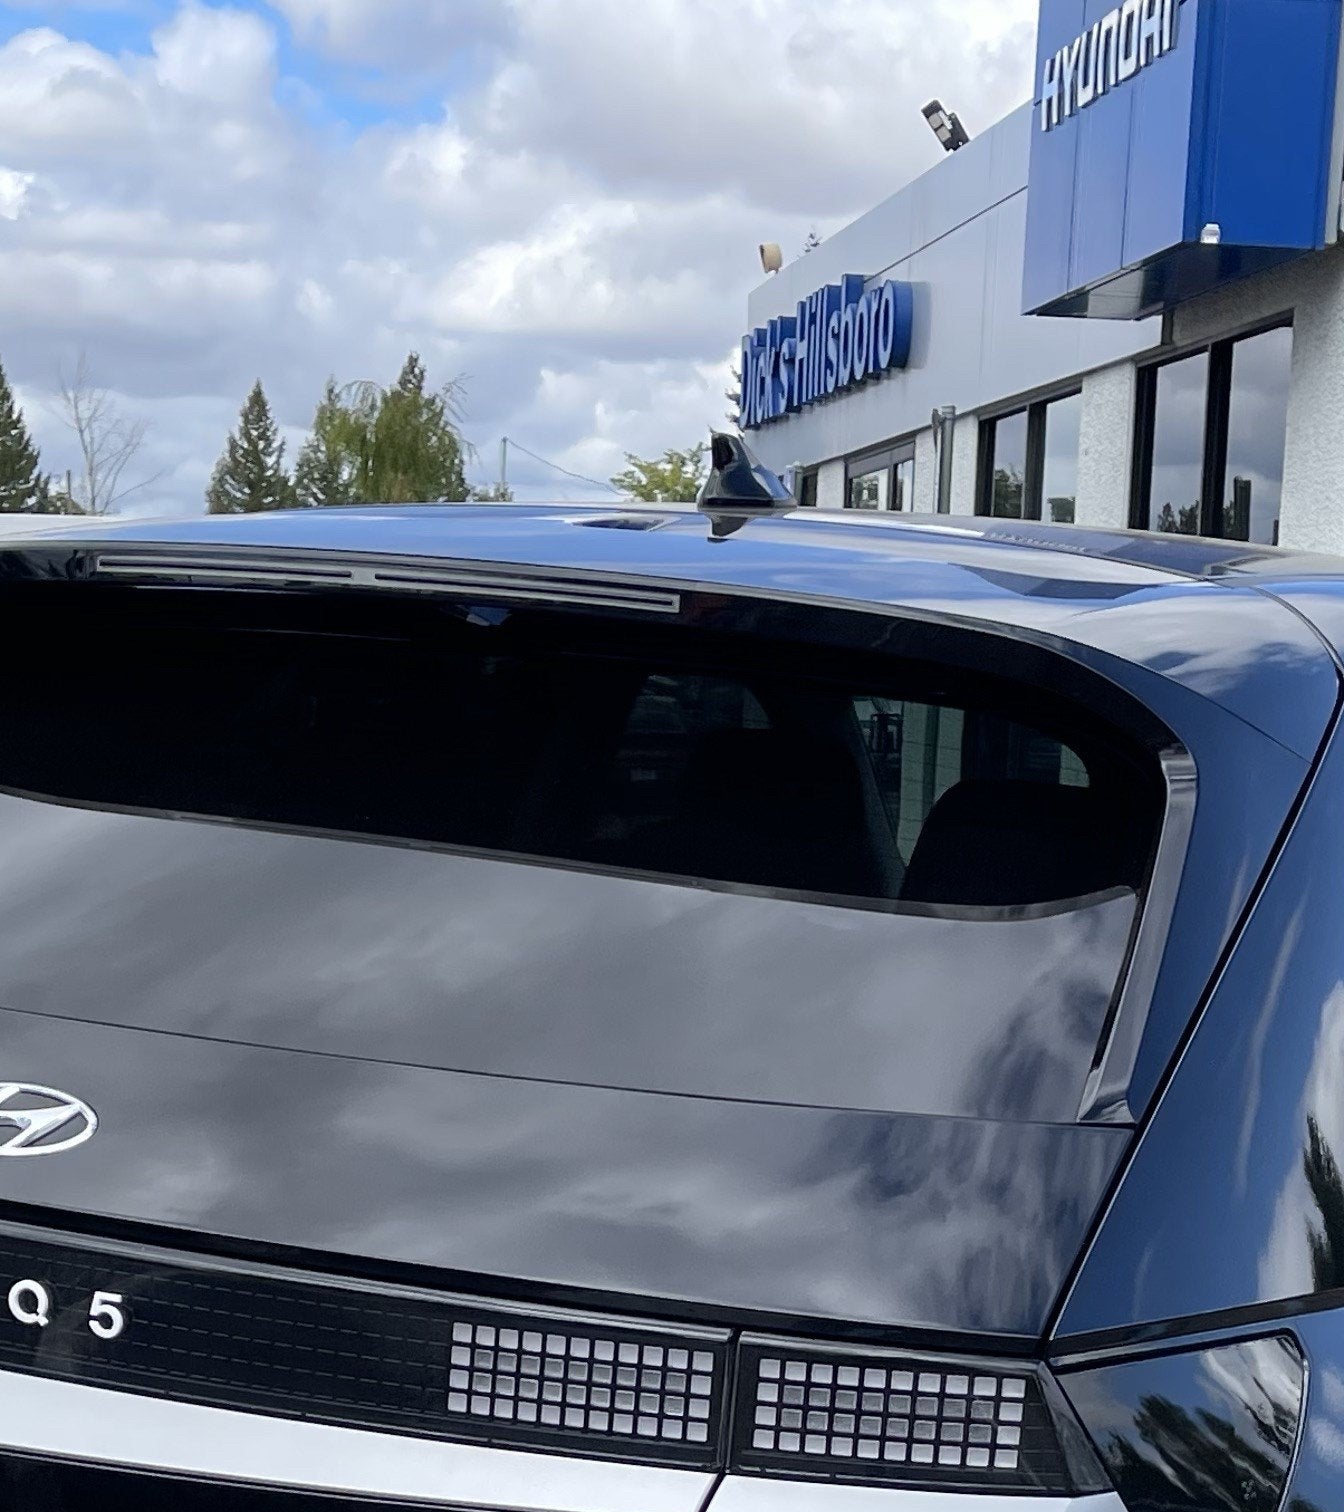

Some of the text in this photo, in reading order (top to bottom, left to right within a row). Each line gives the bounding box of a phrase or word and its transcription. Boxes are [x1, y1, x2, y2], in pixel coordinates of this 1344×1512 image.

[1041, 0, 1176, 132] HYUNDAI
[739, 273, 904, 430] Dick's Hillsboro
[88, 1290, 124, 1339] 5
